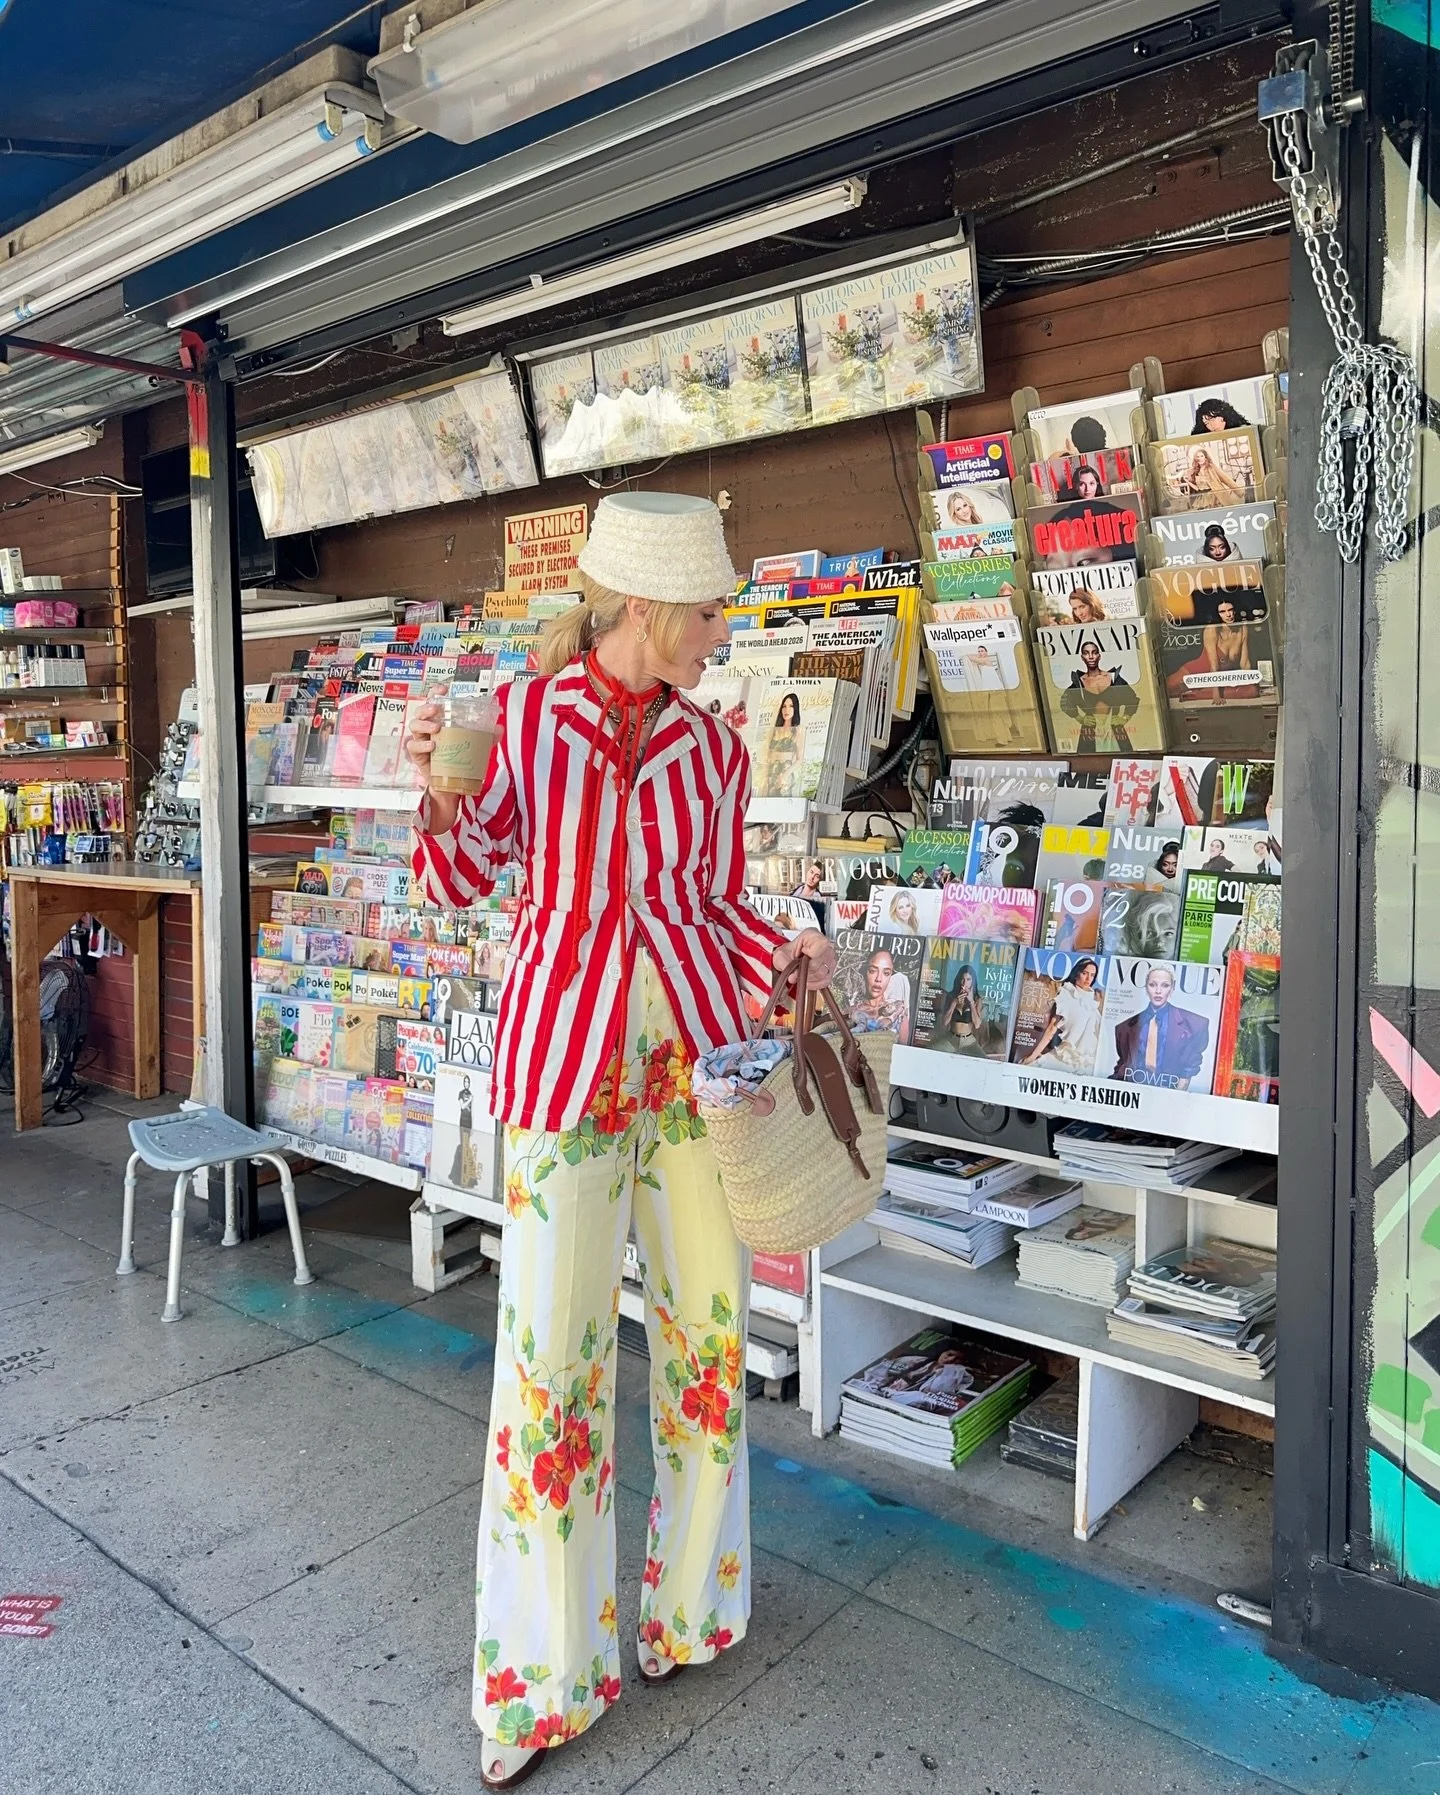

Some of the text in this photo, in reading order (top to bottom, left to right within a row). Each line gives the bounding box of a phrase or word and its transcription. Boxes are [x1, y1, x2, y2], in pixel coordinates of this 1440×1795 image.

[880, 255, 957, 287] CALIFORNIA
[805, 277, 877, 308] CALIFORNIA
[881, 278, 928, 300] HOMES
[806, 300, 849, 321] HOMES
[953, 444, 976, 456] TIME
[946, 457, 991, 473] Artificial
[940, 468, 1001, 485] Intelligence
[511, 511, 582, 543] WARNING
[1034, 508, 1138, 557] creatura
[1156, 511, 1270, 542] Numéro
[520, 538, 571, 559] THESE PREMISES
[508, 562, 535, 577] SECURED
[536, 560, 544, 573] BY
[829, 555, 877, 573] TRICYCLE
[521, 575, 569, 591] ALARM SYSTEM
[816, 582, 834, 591] TIME
[867, 567, 916, 590] What
[1156, 563, 1262, 599] VOGUE
[761, 583, 783, 592] SEARCH
[739, 590, 780, 606] ETERNAL
[485, 608, 504, 618] Now
[839, 619, 859, 630] LIFE
[815, 638, 877, 647] REVOLUTION
[831, 630, 882, 639] AMERICAN
[1040, 624, 1141, 657] BAZAAR
[749, 639, 770, 648] WORLD
[769, 638, 789, 646] AHEAD
[937, 650, 954, 658] THE
[797, 656, 831, 669] THE
[938, 658, 965, 667] STYLE
[385, 667, 407, 676] Super
[427, 667, 447, 675] Jane
[727, 665, 774, 678] The New
[940, 668, 965, 676] ISSUE
[1185, 673, 1260, 685] @THEKOSHERNEWS
[379, 699, 406, 712] New
[933, 779, 992, 801] Num
[1221, 765, 1254, 814] W
[978, 824, 1019, 856] 10
[303, 871, 324, 882] MAD
[1108, 863, 1146, 880] 258
[947, 884, 1036, 907] COSMOPOLITAN
[1052, 882, 1094, 915] 10
[1185, 911, 1214, 923] PARIS
[837, 932, 921, 957] CULTURED
[927, 937, 1017, 966] VANITY FAIR
[392, 950, 409, 960] Super
[427, 948, 470, 965] POKÉMON
[306, 977, 330, 989] Poké
[985, 967, 1013, 984] Kylie
[1115, 958, 1222, 998] VOUE
[432, 978, 451, 1001] 10
[983, 982, 1004, 1004] Top
[996, 981, 1011, 992] on
[1022, 985, 1050, 1000] GETS
[398, 1024, 419, 1039] People
[1124, 1066, 1181, 1090] POWER
[1018, 1076, 1142, 1110] WOMEN'S FASHION
[324, 1149, 348, 1164] PUZZLES
[975, 1203, 1027, 1223] LAMPOON
[0, 1599, 53, 1609] WHAT IS
[0, 1610, 35, 1623] YOUR
[1, 1624, 48, 1635] SONG?
